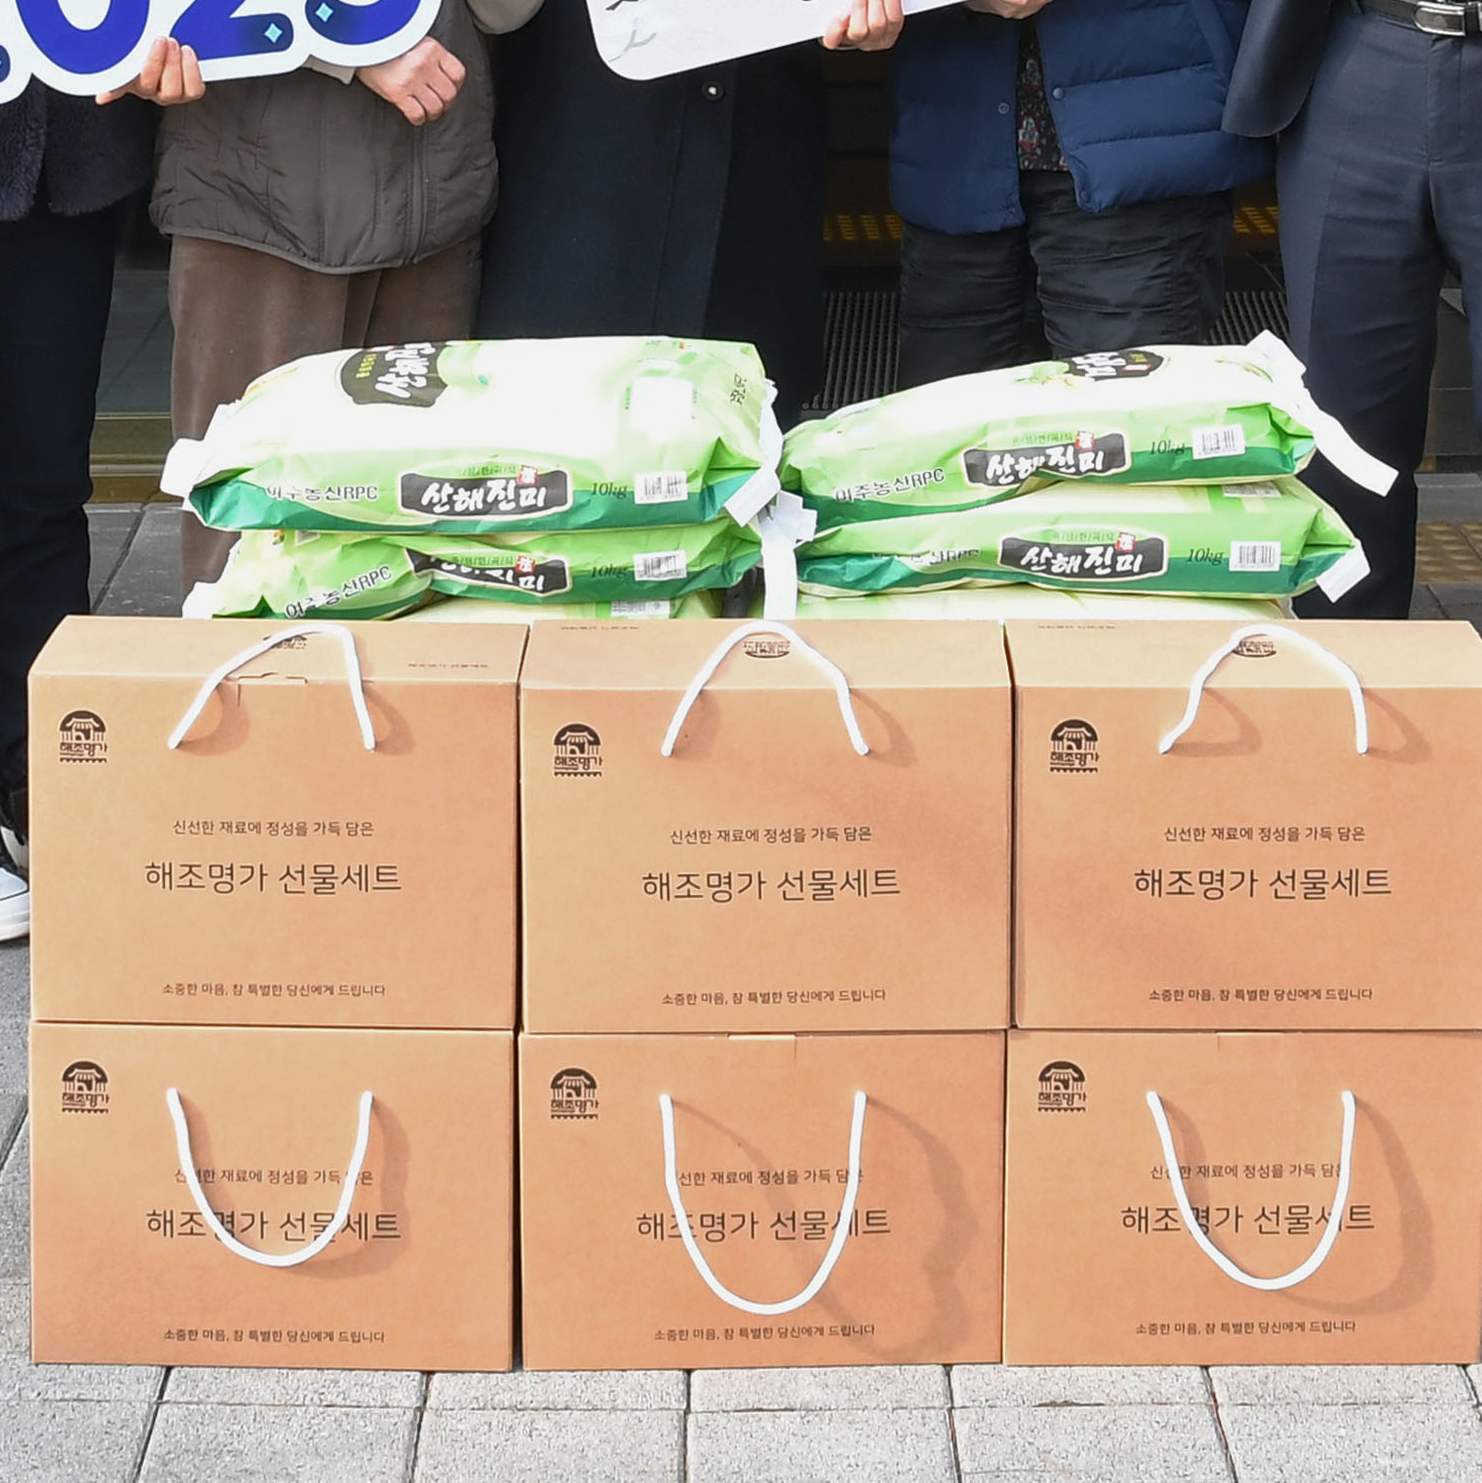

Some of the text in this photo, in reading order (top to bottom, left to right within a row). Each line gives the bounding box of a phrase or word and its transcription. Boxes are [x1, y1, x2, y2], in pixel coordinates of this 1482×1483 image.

[985, 444, 1105, 486] 산해진미
[421, 478, 547, 514] 산해진미
[591, 482, 628, 500] 10kg
[1019, 545, 1143, 576] 산해진미
[1186, 547, 1225, 565] 10kg
[173, 819, 374, 837] 신선한 재료에 정성을 가득 담은
[670, 826, 872, 845] 신선한 재료에 정성을 가득 담은
[1164, 826, 1366, 843] 신선한 재료에 정성을 가득 담은
[144, 860, 403, 896] 해조명가 선물세트
[641, 868, 902, 904] 해조명가 선물세트
[1133, 867, 1393, 901] 해조명가 선물세트
[163, 983, 198, 996] 소중한
[247, 984, 283, 997] 특별한
[286, 983, 335, 998] 당신에게
[338, 984, 386, 998] 드립니다
[662, 993, 698, 1006] 소중한
[747, 991, 783, 1005] 특별한
[786, 990, 835, 1005] 당신에게
[838, 989, 886, 1003] 드립니다
[1148, 989, 1185, 1003] 소중한
[1234, 989, 1270, 1003] 특별한
[1273, 988, 1322, 1002] 당신에게
[1325, 988, 1373, 1001] 드립니다
[220, 1169, 263, 1184] 재료에
[267, 1169, 308, 1186] 정성을
[313, 1169, 340, 1186] 가득
[710, 1170, 753, 1185] 재료에
[757, 1169, 799, 1186] 정성을
[804, 1168, 831, 1184] 가득
[1196, 1164, 1238, 1179] 재료에
[1243, 1164, 1284, 1180] 정성을
[1289, 1163, 1316, 1178] 가득
[164, 1328, 199, 1342] 소중한
[248, 1329, 283, 1344] 특별한
[286, 1329, 335, 1344] 당신에게
[338, 1331, 385, 1344] 드립니다
[654, 1329, 689, 1342] 소중한
[738, 1327, 774, 1341] 특별한
[777, 1325, 825, 1340] 당신에게
[828, 1324, 875, 1338] 드립니다
[1136, 1322, 1171, 1336] 소중한
[1220, 1322, 1255, 1335] 특별한
[1258, 1320, 1306, 1335] 당신에게
[1309, 1320, 1356, 1334] 드립니다
